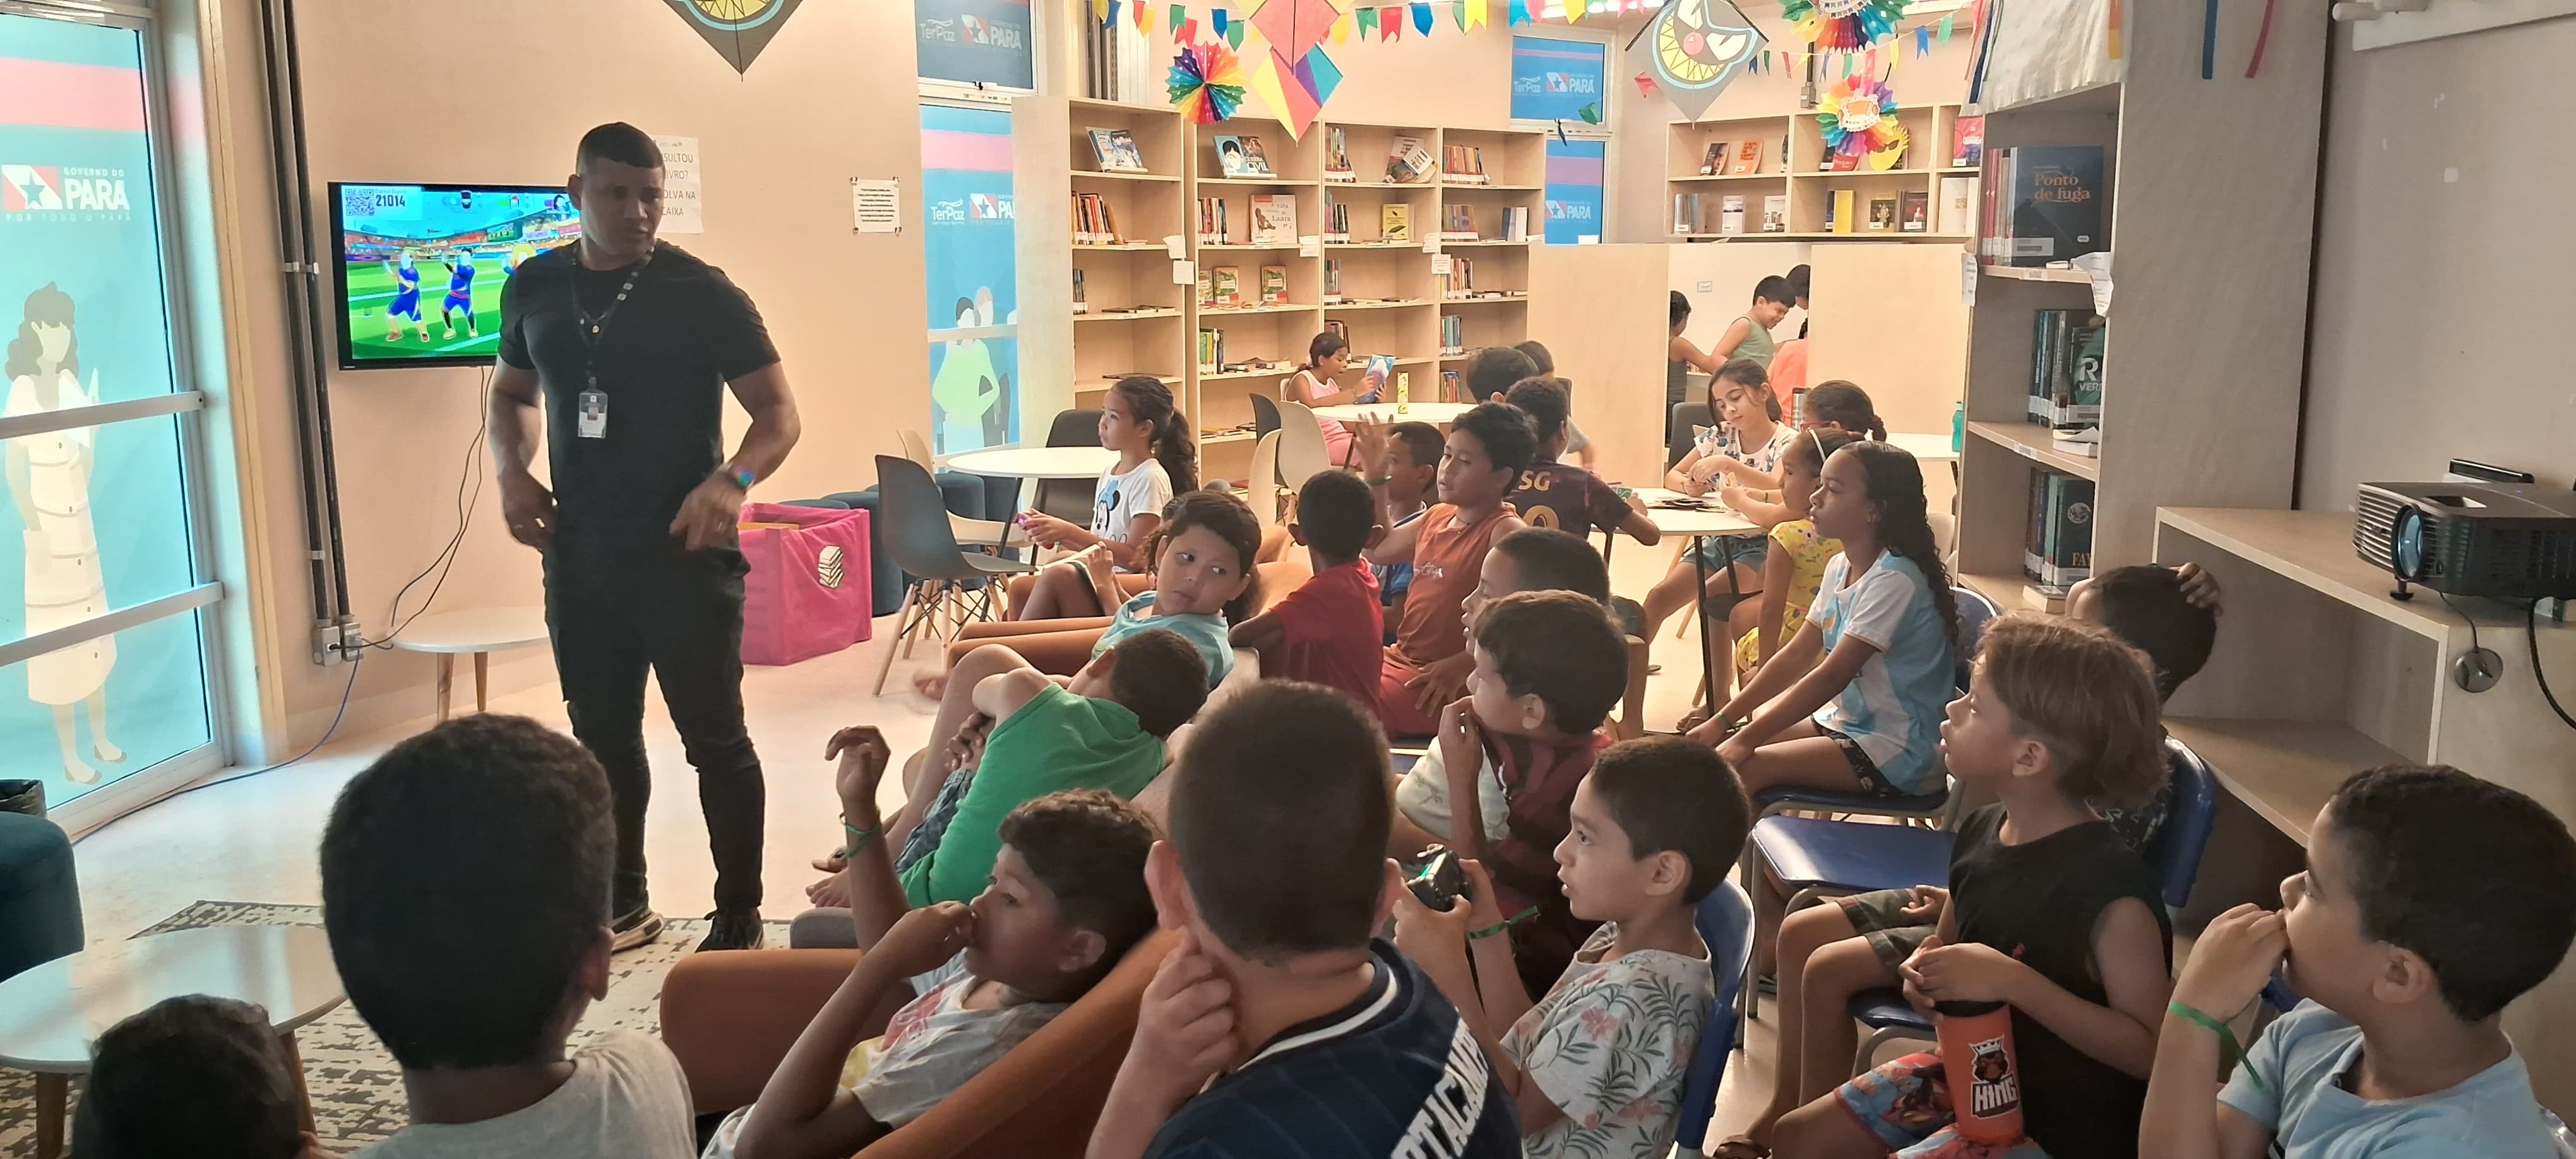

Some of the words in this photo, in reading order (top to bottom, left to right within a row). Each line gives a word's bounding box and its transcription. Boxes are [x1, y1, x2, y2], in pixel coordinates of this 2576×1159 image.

[662, 153, 693, 163] SULTOU
[63, 167, 108, 176] GOVERNO
[112, 169, 124, 177] DO
[2035, 172, 2078, 186] Ponto
[376, 194, 405, 207] 21014
[686, 191, 696, 199] NA
[2035, 187, 2053, 200] de
[2058, 187, 2091, 203] fuga
[930, 206, 965, 221] TerPaz
[1975, 1076, 2017, 1113] KING
